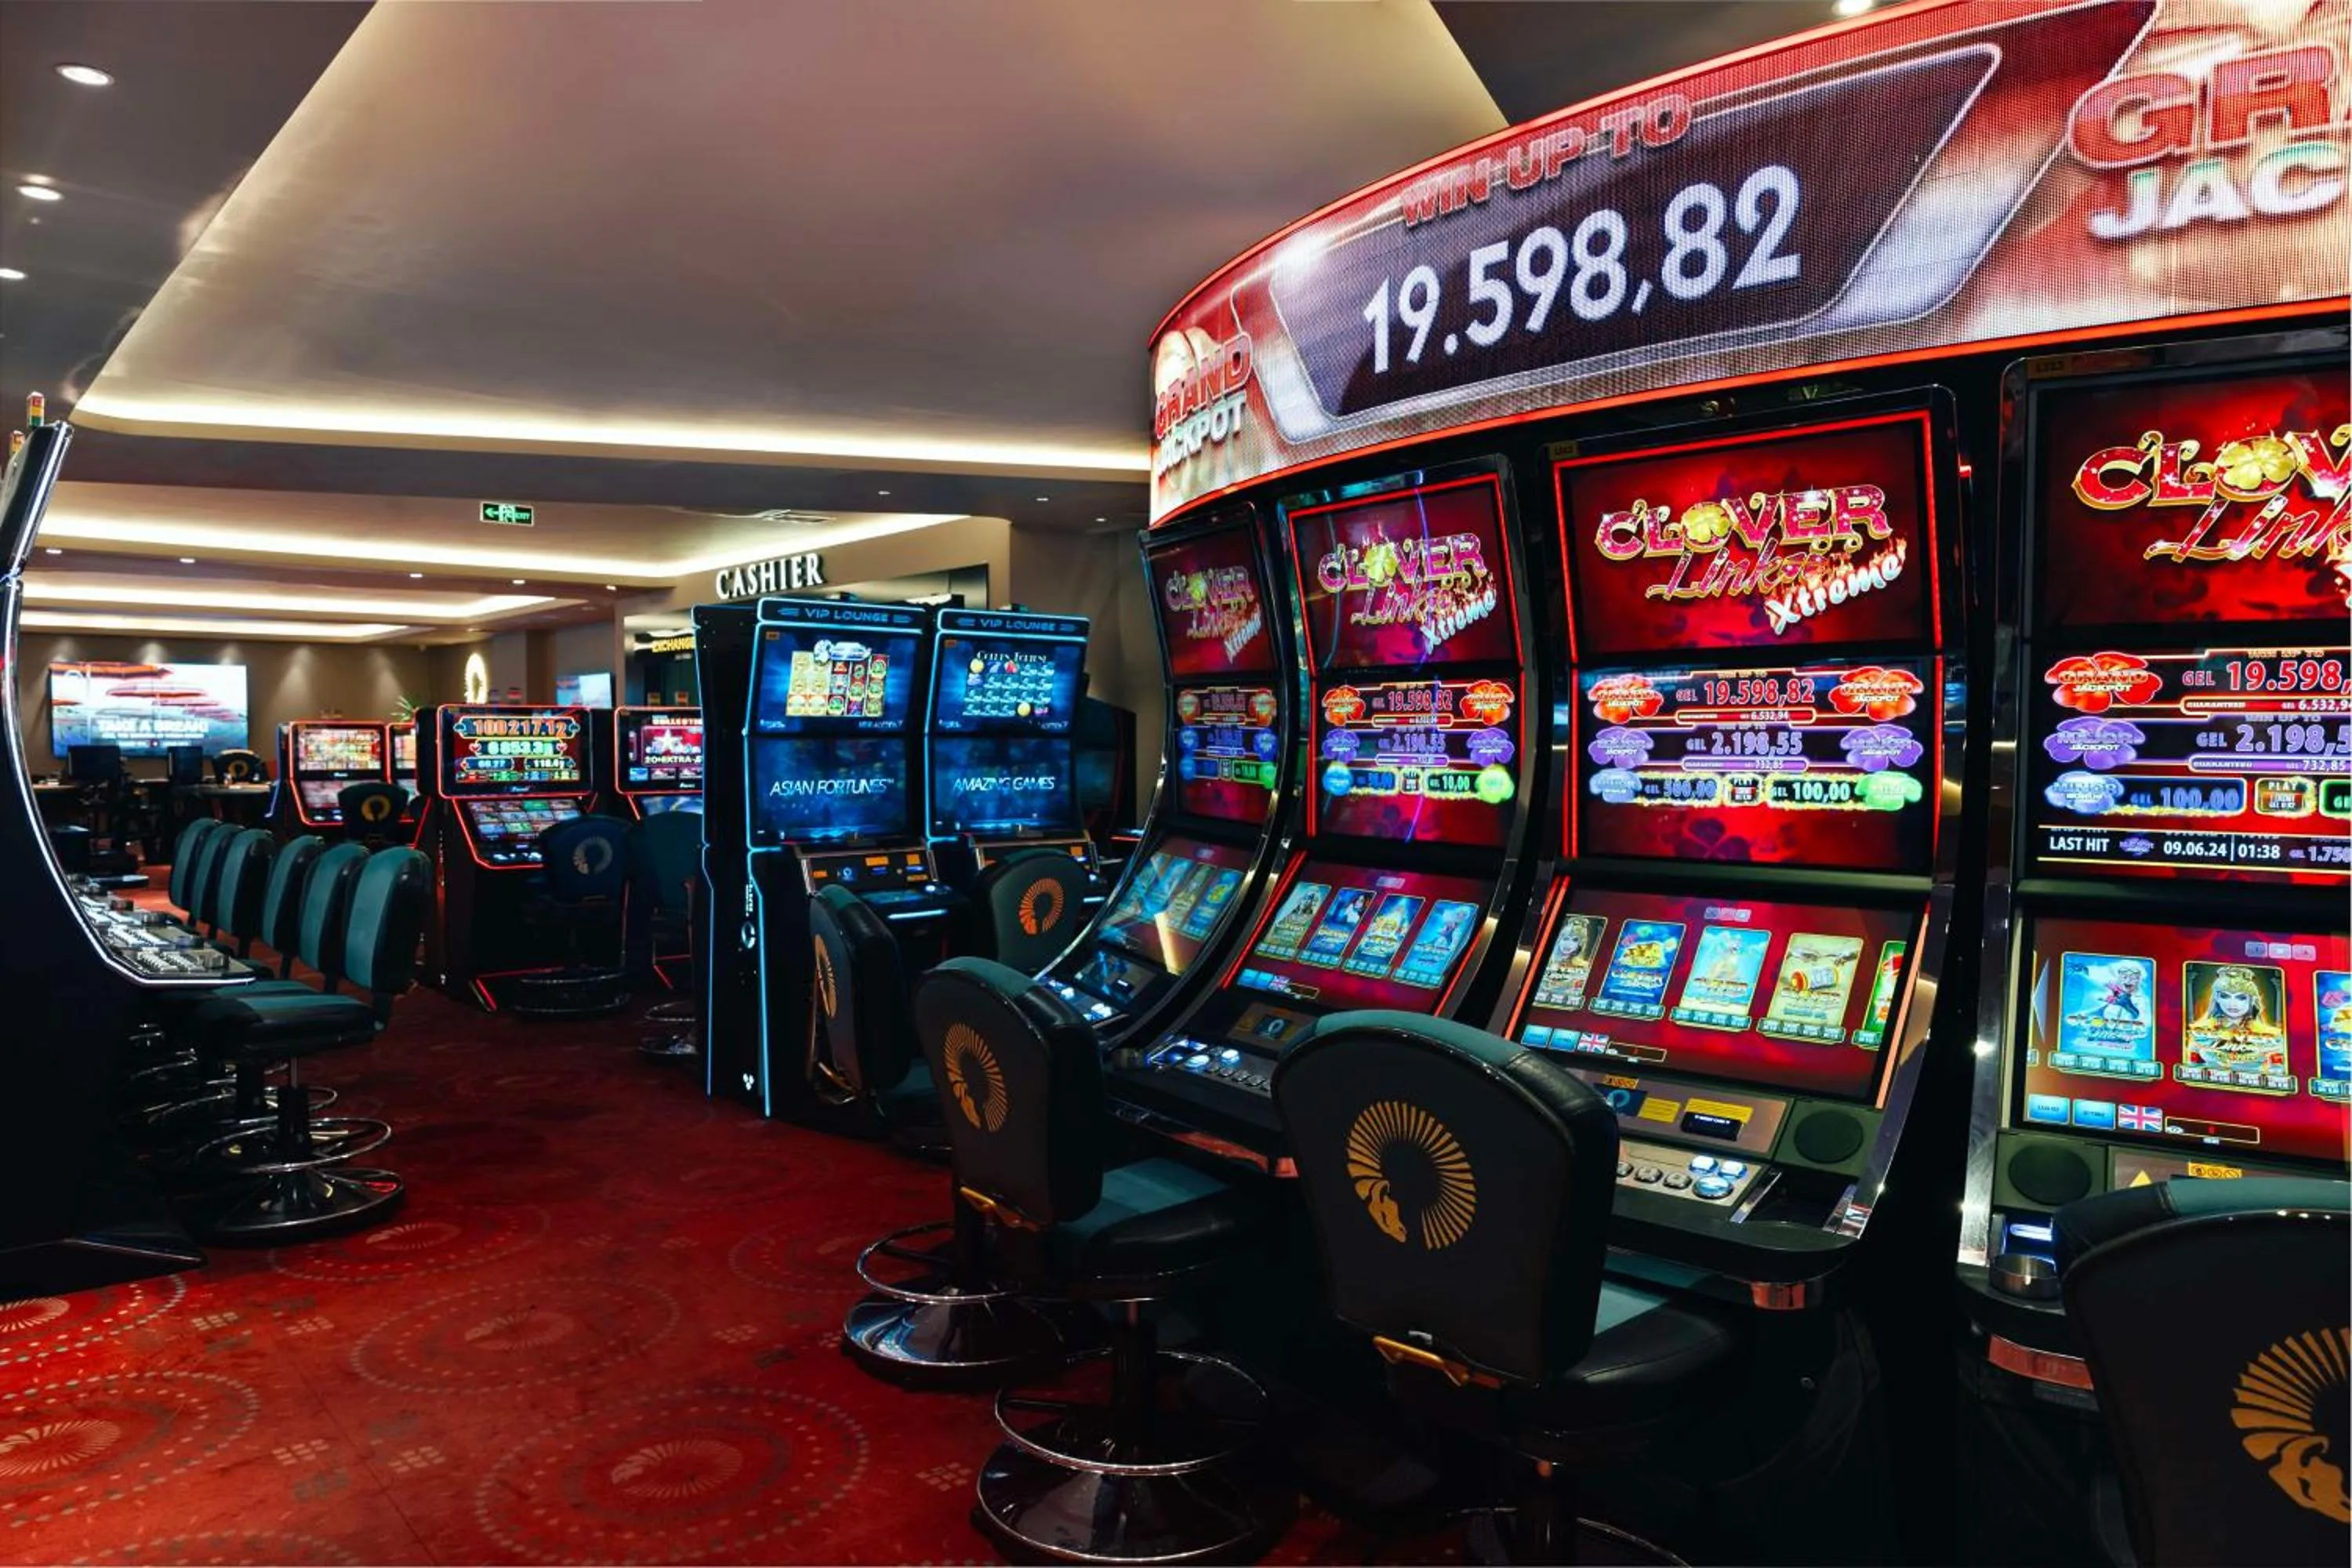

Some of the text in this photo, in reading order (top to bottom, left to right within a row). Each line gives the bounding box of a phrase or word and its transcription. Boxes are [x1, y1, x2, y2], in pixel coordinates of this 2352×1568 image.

[2068, 40, 2350, 170] GR
[1401, 93, 1693, 227] WIN UP TO
[1363, 165, 1802, 375] 19.598,82
[1156, 332, 1253, 441] GRAND
[1595, 483, 1893, 560] CLOVER
[1317, 532, 1489, 593] CLOVER
[715, 553, 825, 601] CASHIER
[1763, 547, 1905, 636] Xtreme
[804, 608, 889, 622] VIP LOUNGE
[980, 618, 1056, 631] VIP LOUNGE
[2072, 684, 2133, 693] JACKPOT
[2182, 670, 2216, 686] GEL
[1704, 678, 1815, 707] 19.598,82
[1711, 731, 1803, 759] 2.198,55
[2196, 732, 2228, 747] GEL
[2303, 759, 2347, 772] 732,85
[769, 780, 815, 797] ASIAN
[953, 776, 1057, 792] AMAZING GAMES
[1792, 782, 1851, 803] 100,00
[2049, 836, 2082, 851] LAST
[2085, 838, 2111, 852] HIT
[2162, 840, 2227, 858] 09.06.24
[2238, 843, 2281, 859] 01:38
